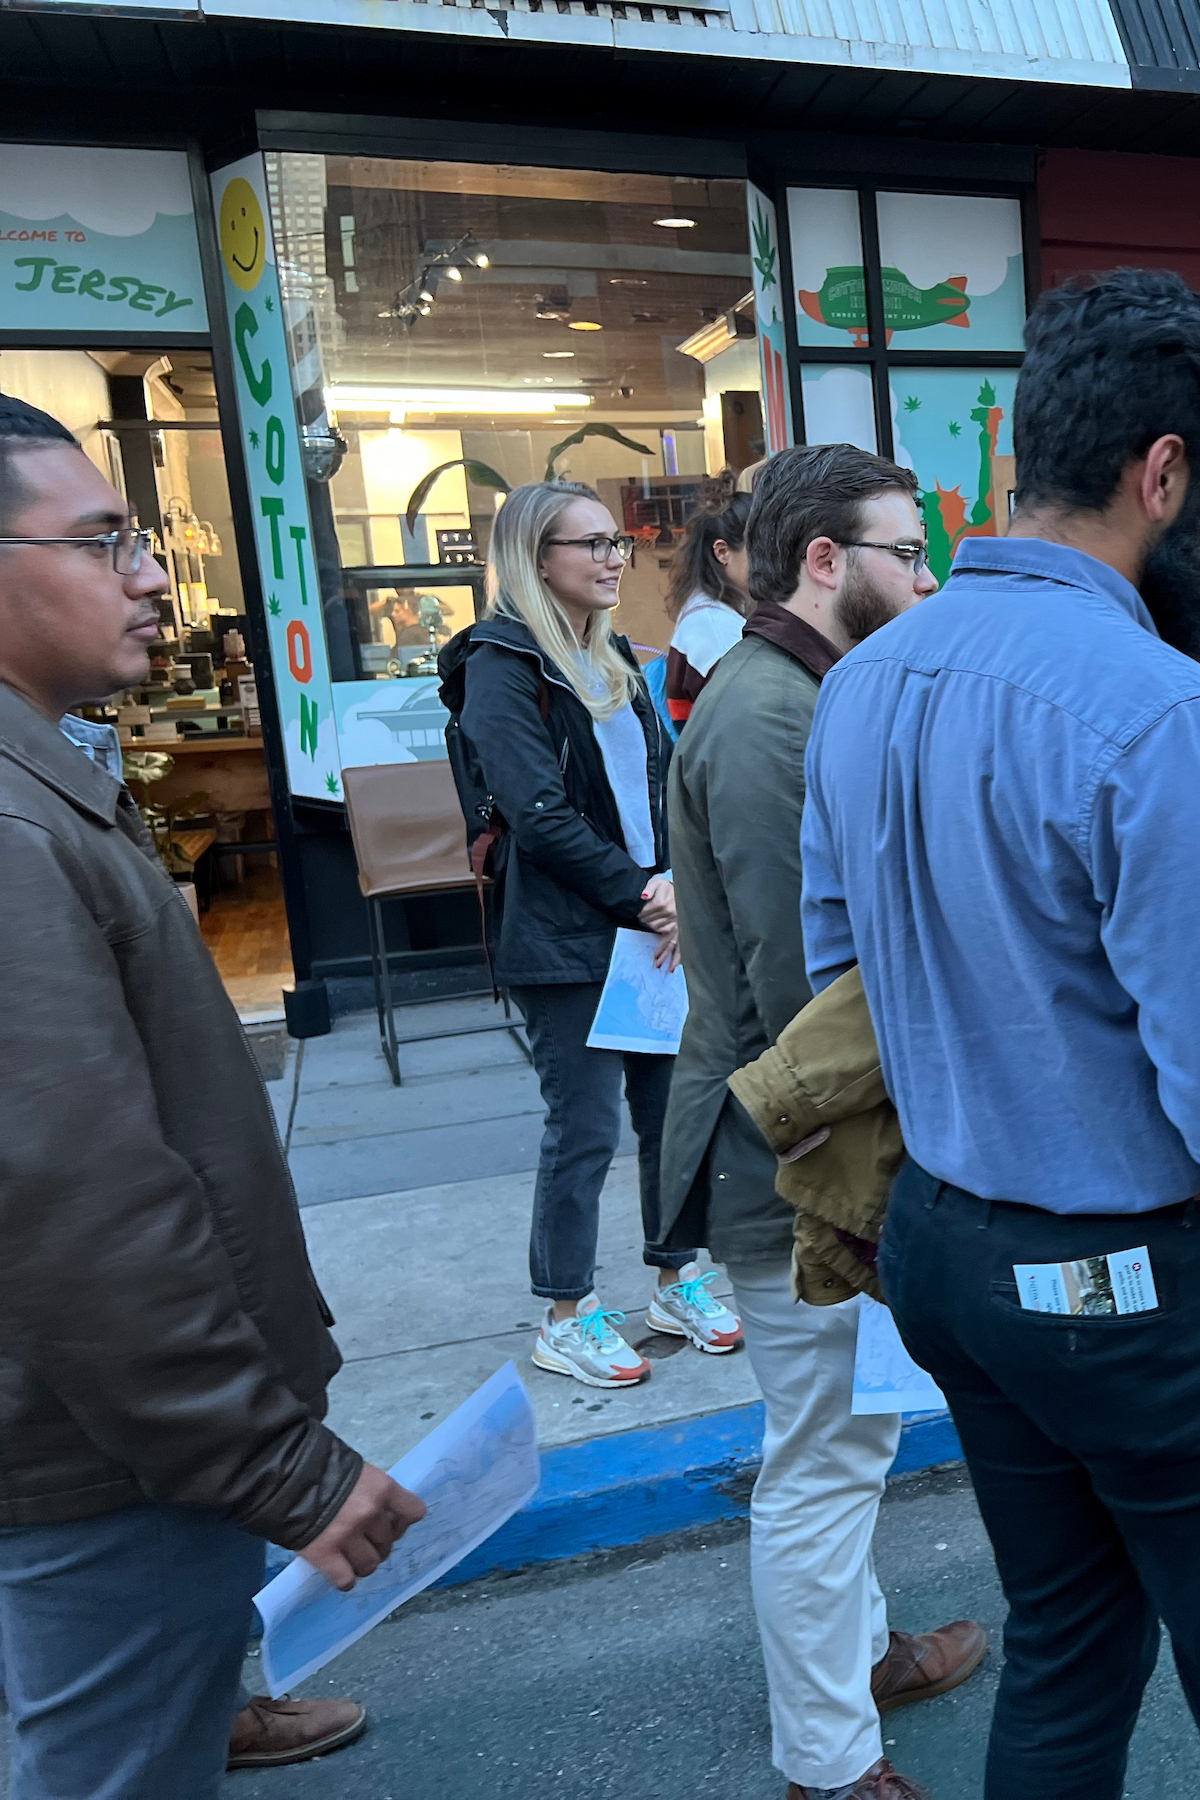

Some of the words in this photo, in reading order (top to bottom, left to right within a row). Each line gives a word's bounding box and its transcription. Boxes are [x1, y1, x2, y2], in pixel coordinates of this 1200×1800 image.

[65, 231, 86, 242] TO
[14, 257, 193, 318] JERSEY
[234, 302, 318, 762] COTTON
